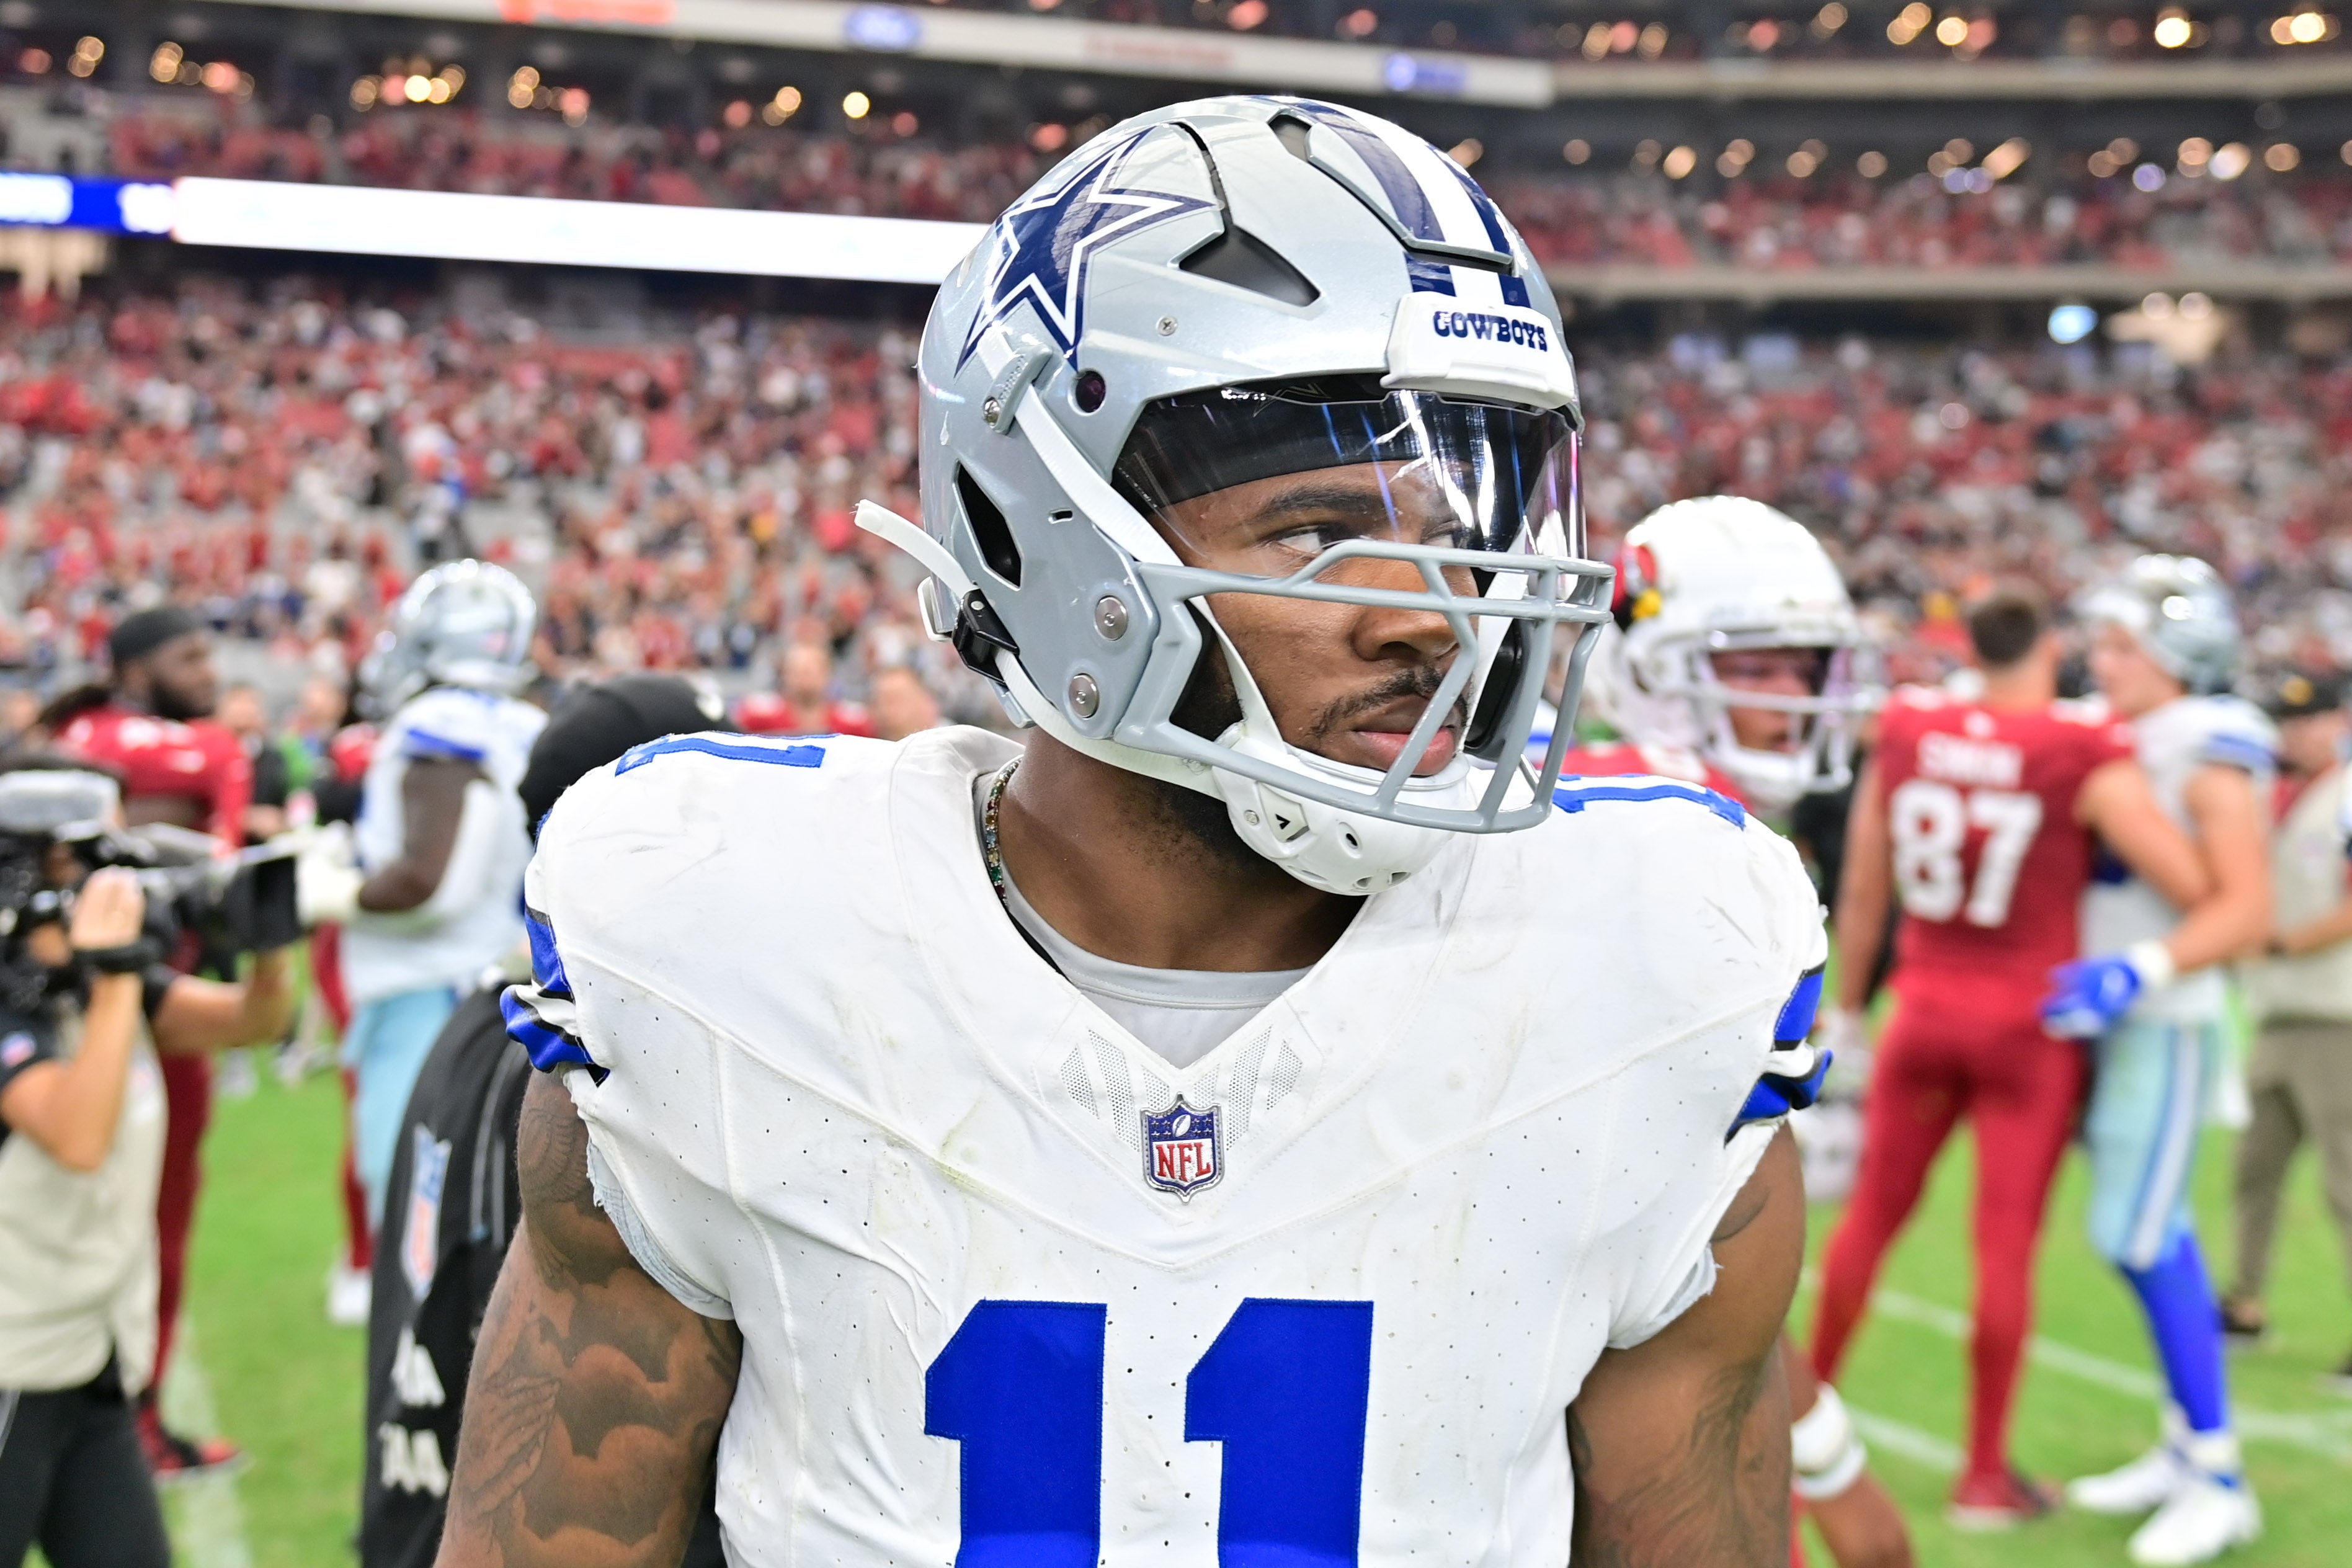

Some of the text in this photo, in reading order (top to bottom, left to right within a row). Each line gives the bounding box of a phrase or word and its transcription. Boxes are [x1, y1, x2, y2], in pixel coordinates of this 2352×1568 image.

[1433, 310, 1548, 352] COWBOYS
[1891, 778, 2042, 929] 87
[1156, 1141, 1211, 1182] NFL
[924, 1296, 1374, 1568] 11
